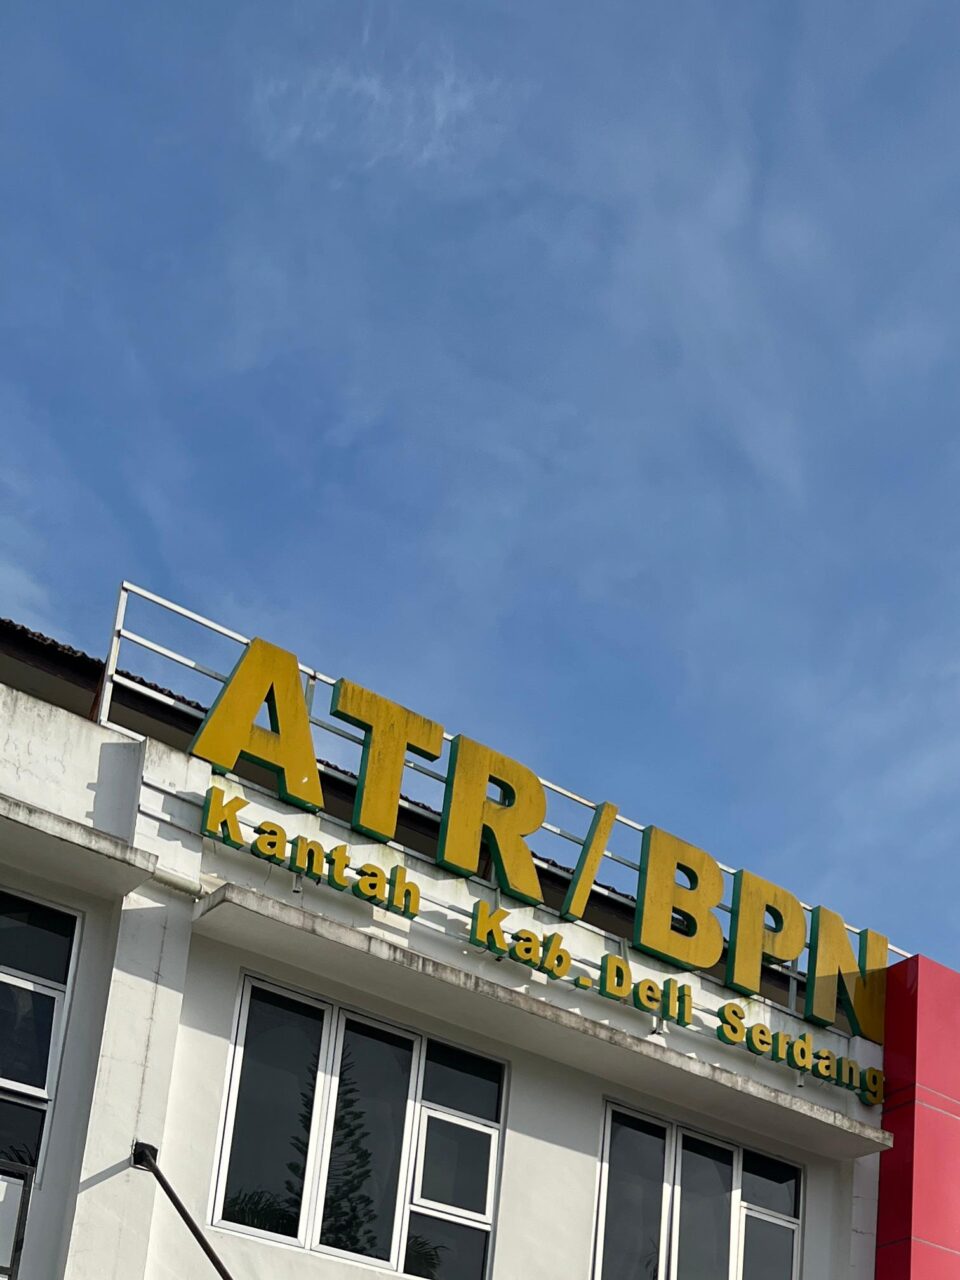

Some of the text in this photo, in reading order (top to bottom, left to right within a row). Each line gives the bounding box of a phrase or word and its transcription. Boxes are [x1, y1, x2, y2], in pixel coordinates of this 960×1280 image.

[190, 636, 889, 1045] ATR/BPN
[201, 786, 885, 1106] Kantah Kab. Deli Serdang
